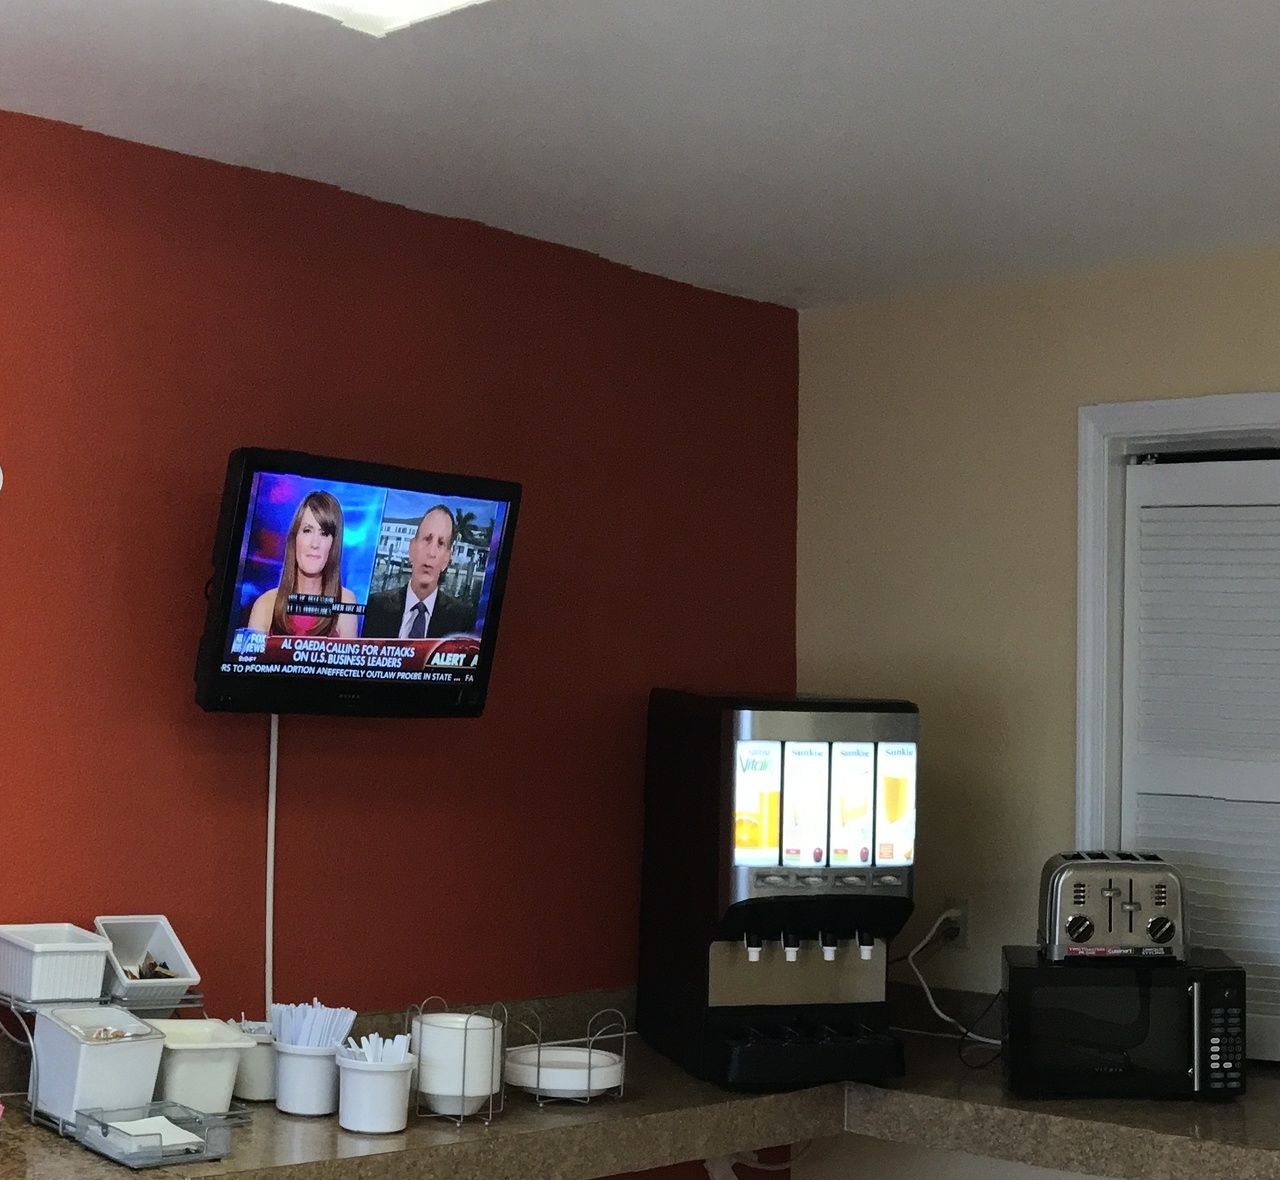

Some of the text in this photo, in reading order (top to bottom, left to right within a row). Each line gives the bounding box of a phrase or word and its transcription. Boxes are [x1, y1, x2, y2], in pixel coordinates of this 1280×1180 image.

[281, 639, 415, 657] AL QAEDA CALLING FOR ATTACKS
[293, 651, 402, 668] ON U.S. BUSINESS LEADERS
[431, 653, 467, 666] ALERT
[232, 664, 244, 673] TO
[366, 670, 396, 679] OUTLAW
[432, 673, 452, 681] STATE
